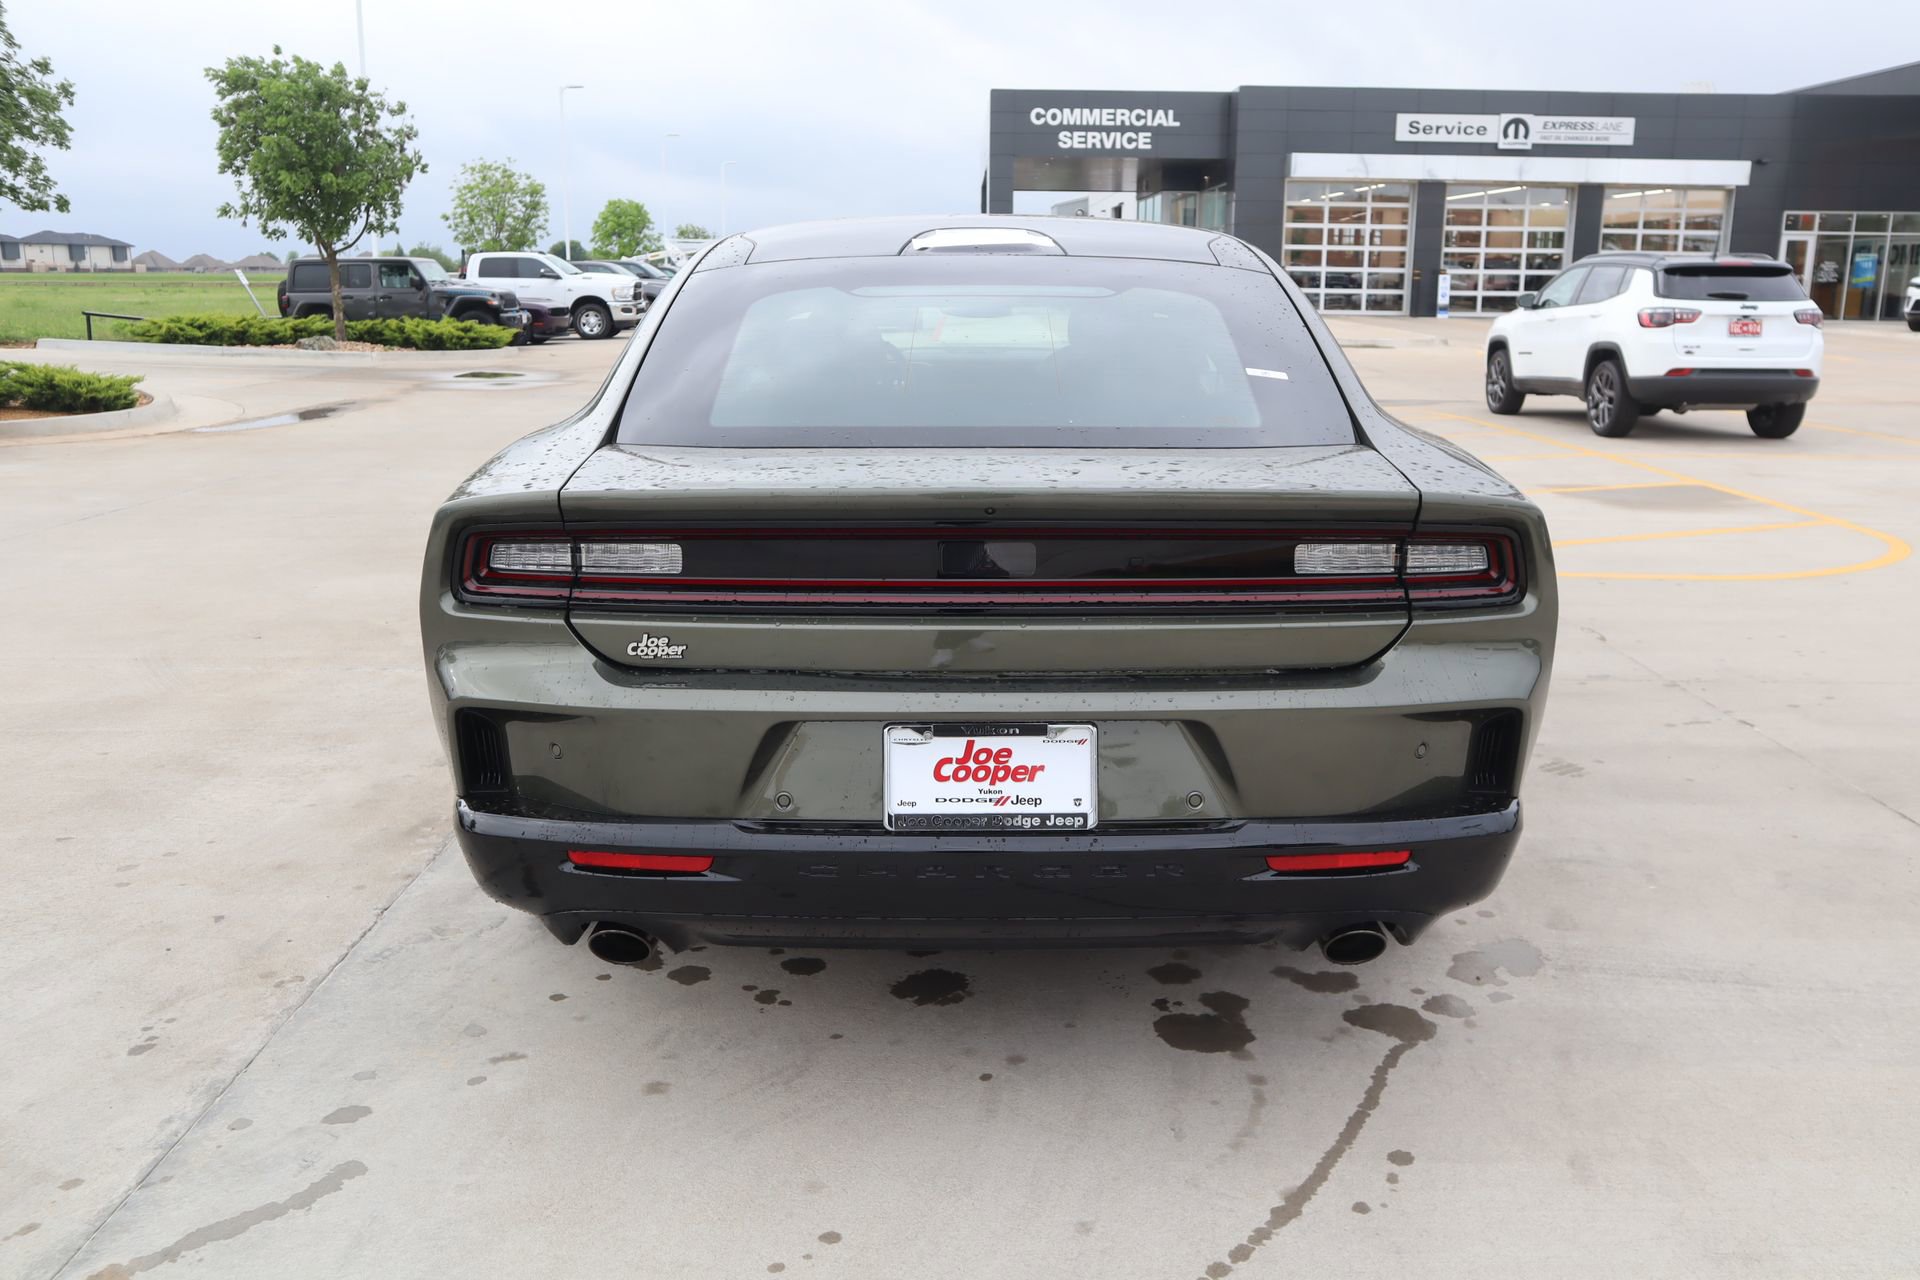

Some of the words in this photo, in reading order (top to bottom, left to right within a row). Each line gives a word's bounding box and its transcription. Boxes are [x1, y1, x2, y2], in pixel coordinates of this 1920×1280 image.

[1030, 107, 1180, 127] COMMERCIAL
[1408, 120, 1488, 136] Service
[1058, 131, 1152, 150] SERVICE
[638, 633, 669, 647] Joe
[627, 642, 686, 657] Cooper
[960, 725, 1020, 736] Yukon
[955, 739, 1013, 764] Joe
[932, 757, 1045, 786] Cooper
[897, 799, 917, 807] Jeep
[1010, 794, 1042, 807] Jeep
[898, 815, 927, 827] Joe
[931, 815, 987, 828] Cooper
[992, 814, 1041, 828] Dodge
[1046, 814, 1084, 828] Jeep
